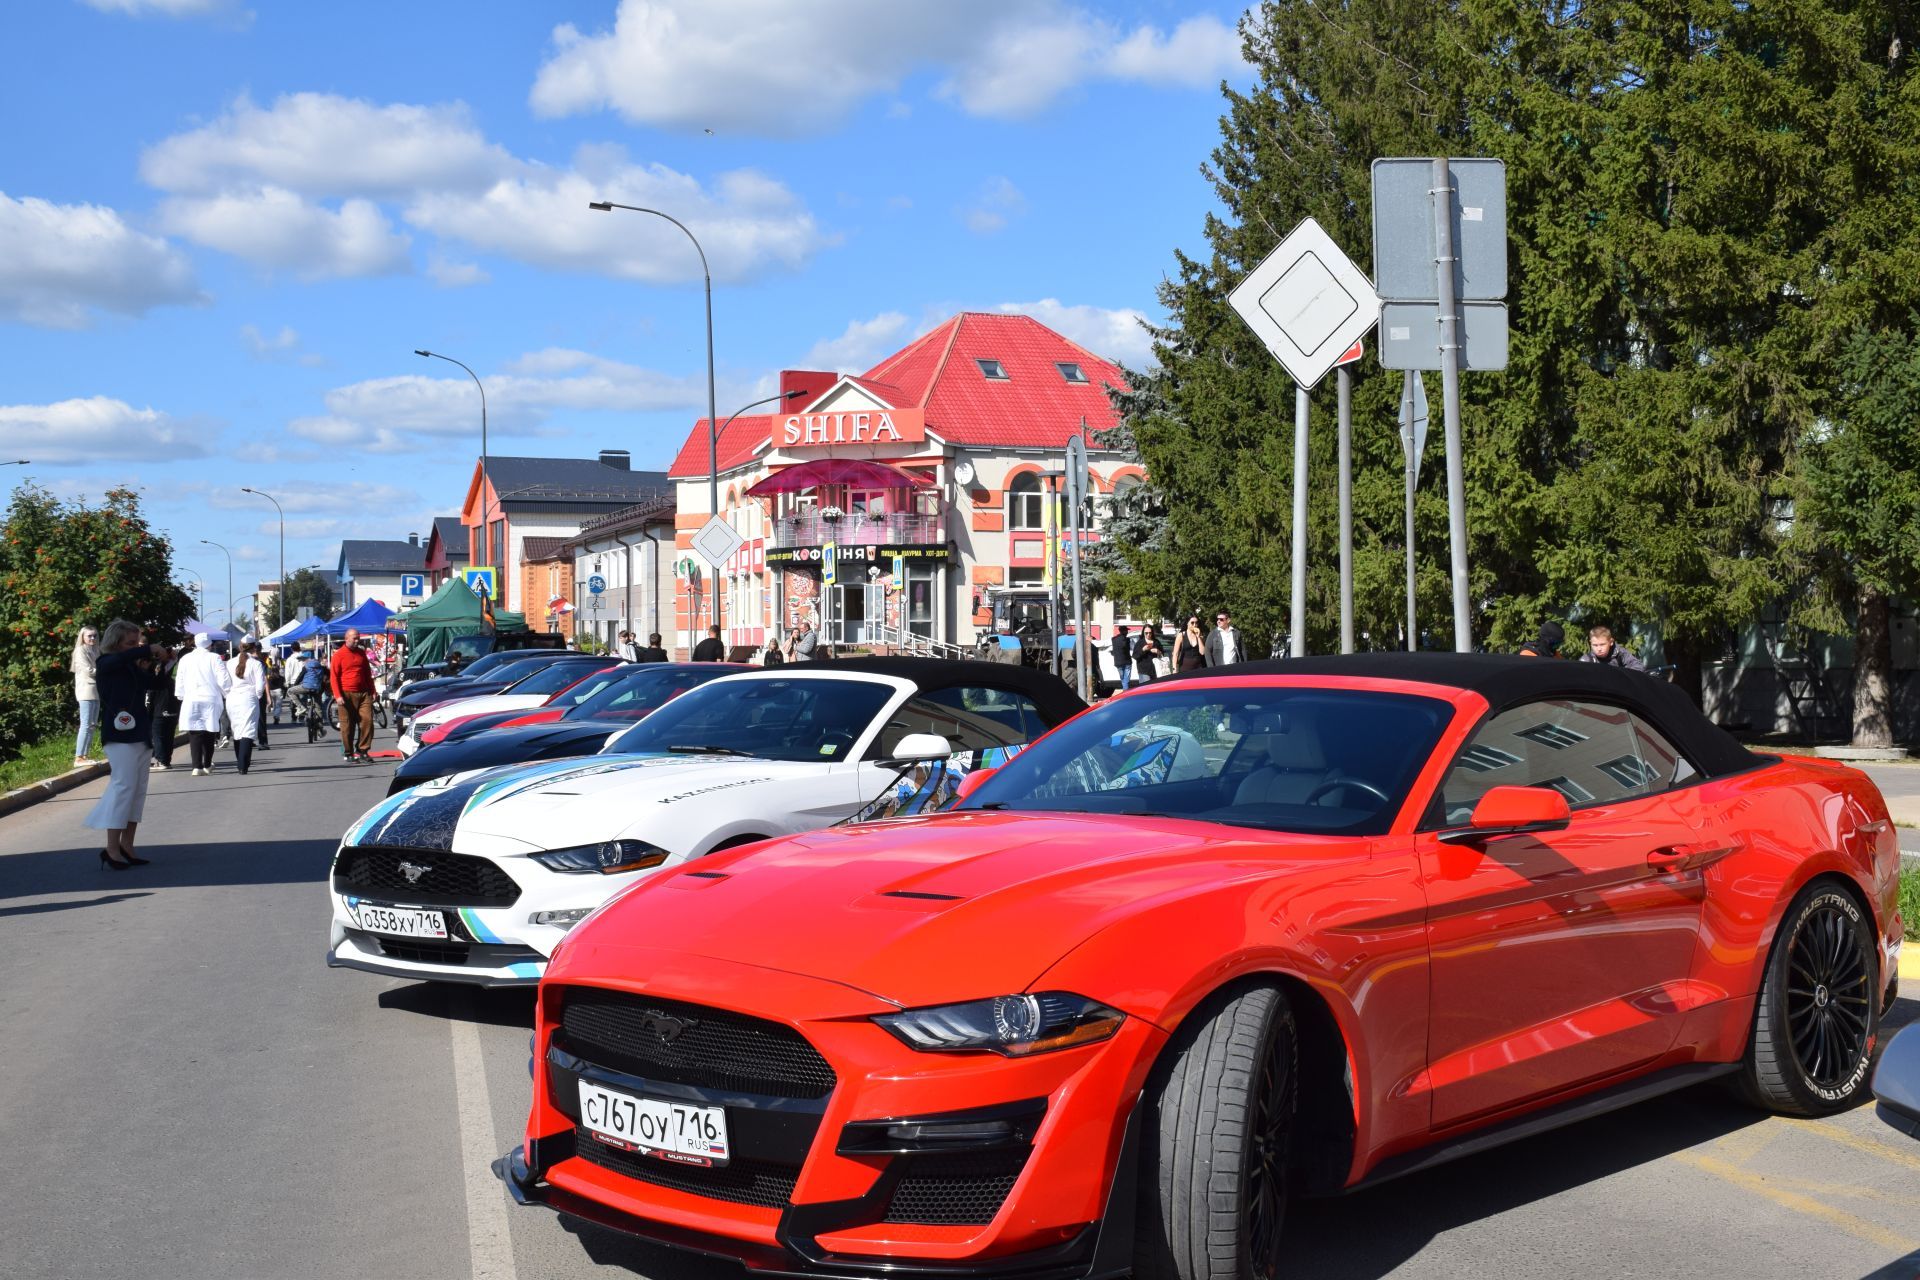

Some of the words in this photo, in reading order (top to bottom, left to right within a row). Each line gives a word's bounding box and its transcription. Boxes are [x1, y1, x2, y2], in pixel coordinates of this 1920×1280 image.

[784, 412, 903, 445] SHIFA
[792, 545, 865, 561] КОФНЯ
[406, 577, 419, 594] P
[416, 911, 441, 930] 716
[1796, 893, 1860, 931] MUSTANG
[1804, 1056, 1870, 1100] MUSTANG
[673, 1108, 718, 1140] 716
[598, 1134, 625, 1147] MUSTANG
[687, 1138, 709, 1151] RUS
[666, 1152, 703, 1164] MUSTANG
